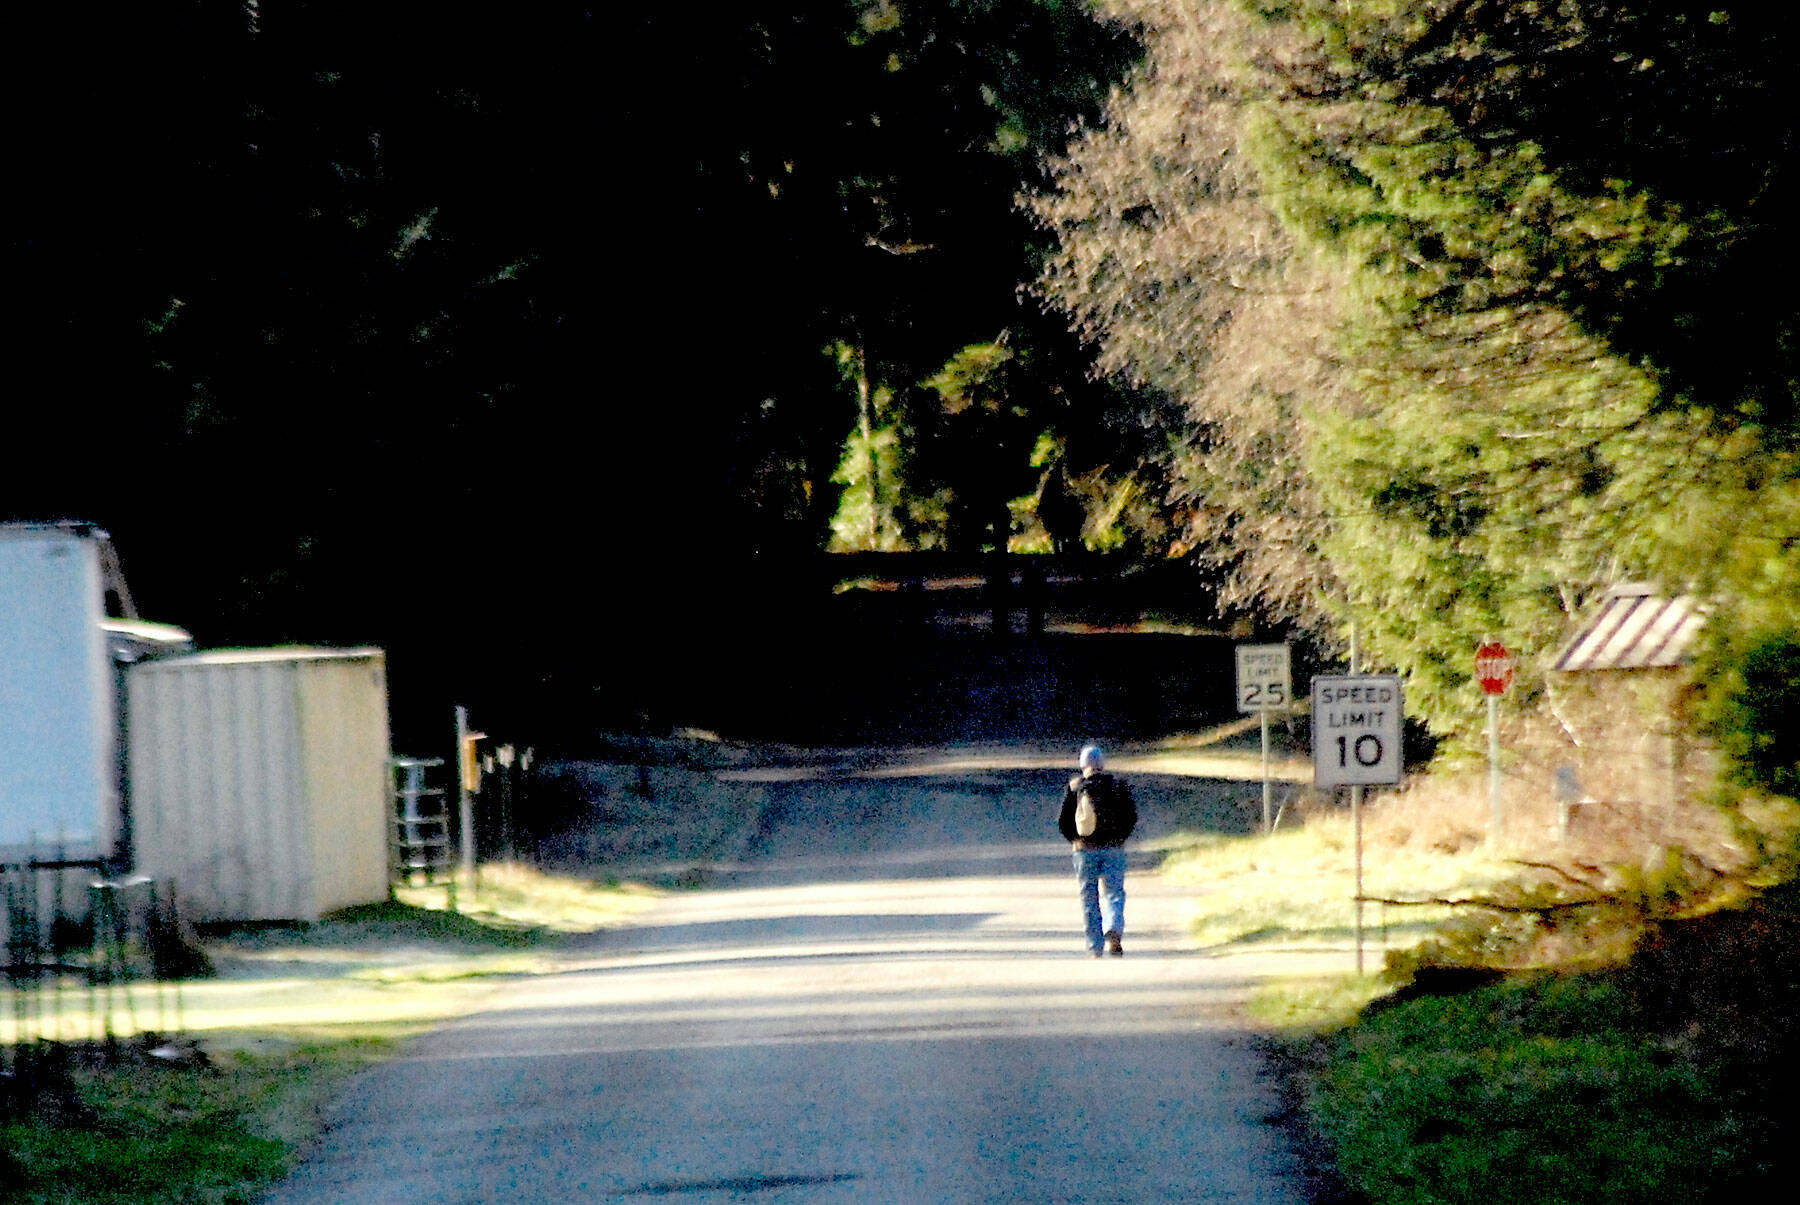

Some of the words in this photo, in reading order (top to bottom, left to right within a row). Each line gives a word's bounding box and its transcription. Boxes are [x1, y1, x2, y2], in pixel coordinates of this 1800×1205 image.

[1244, 653, 1282, 664] SPEED
[1244, 683, 1284, 705] 25
[1322, 688, 1391, 704] SPEED
[1329, 712, 1384, 728] LIMIT
[1336, 734, 1382, 767] 10
